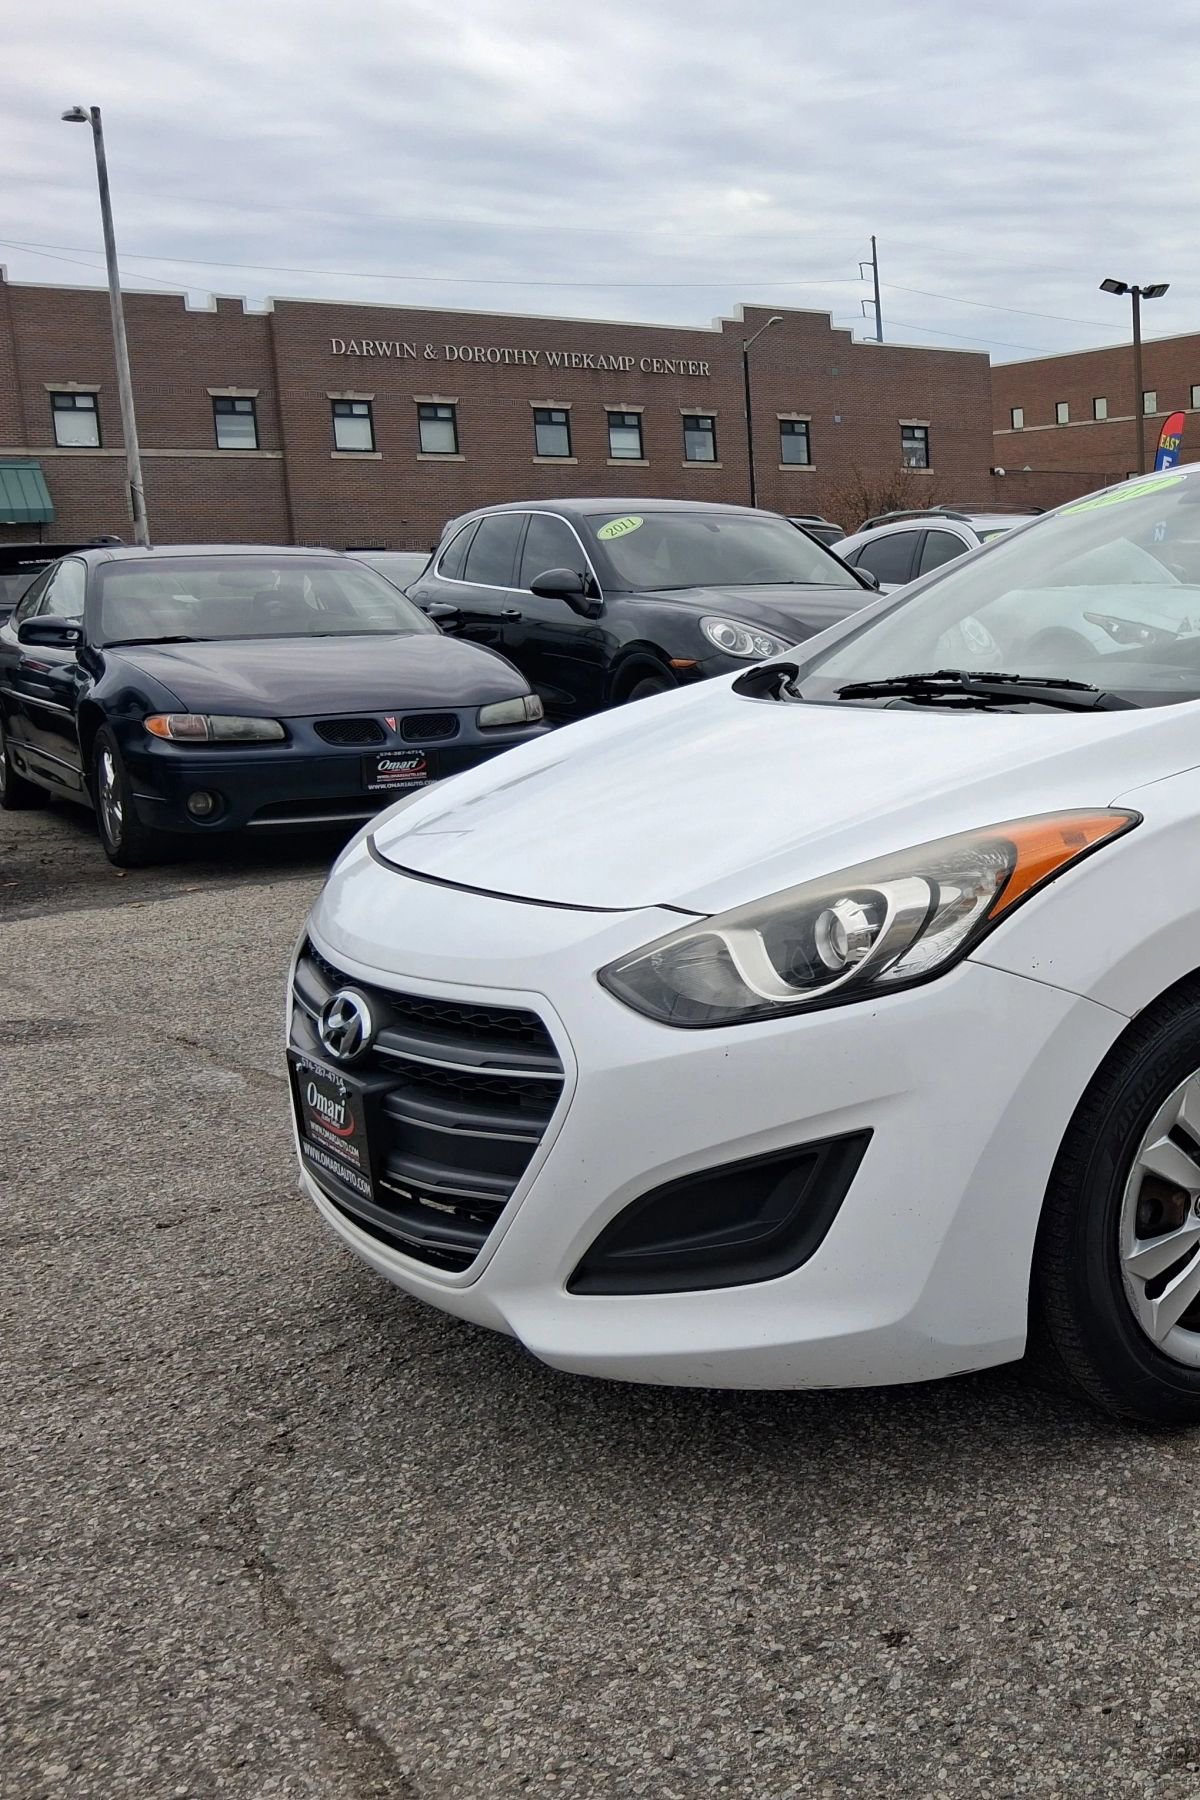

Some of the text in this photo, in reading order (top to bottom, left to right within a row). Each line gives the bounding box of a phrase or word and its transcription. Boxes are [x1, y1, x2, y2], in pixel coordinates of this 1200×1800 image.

[329, 338, 711, 377] DARWIN & DOROTHY WIEKAMP CENTER
[605, 518, 636, 537] 2011
[377, 758, 419, 771] Omari
[307, 1082, 346, 1124] Omari
